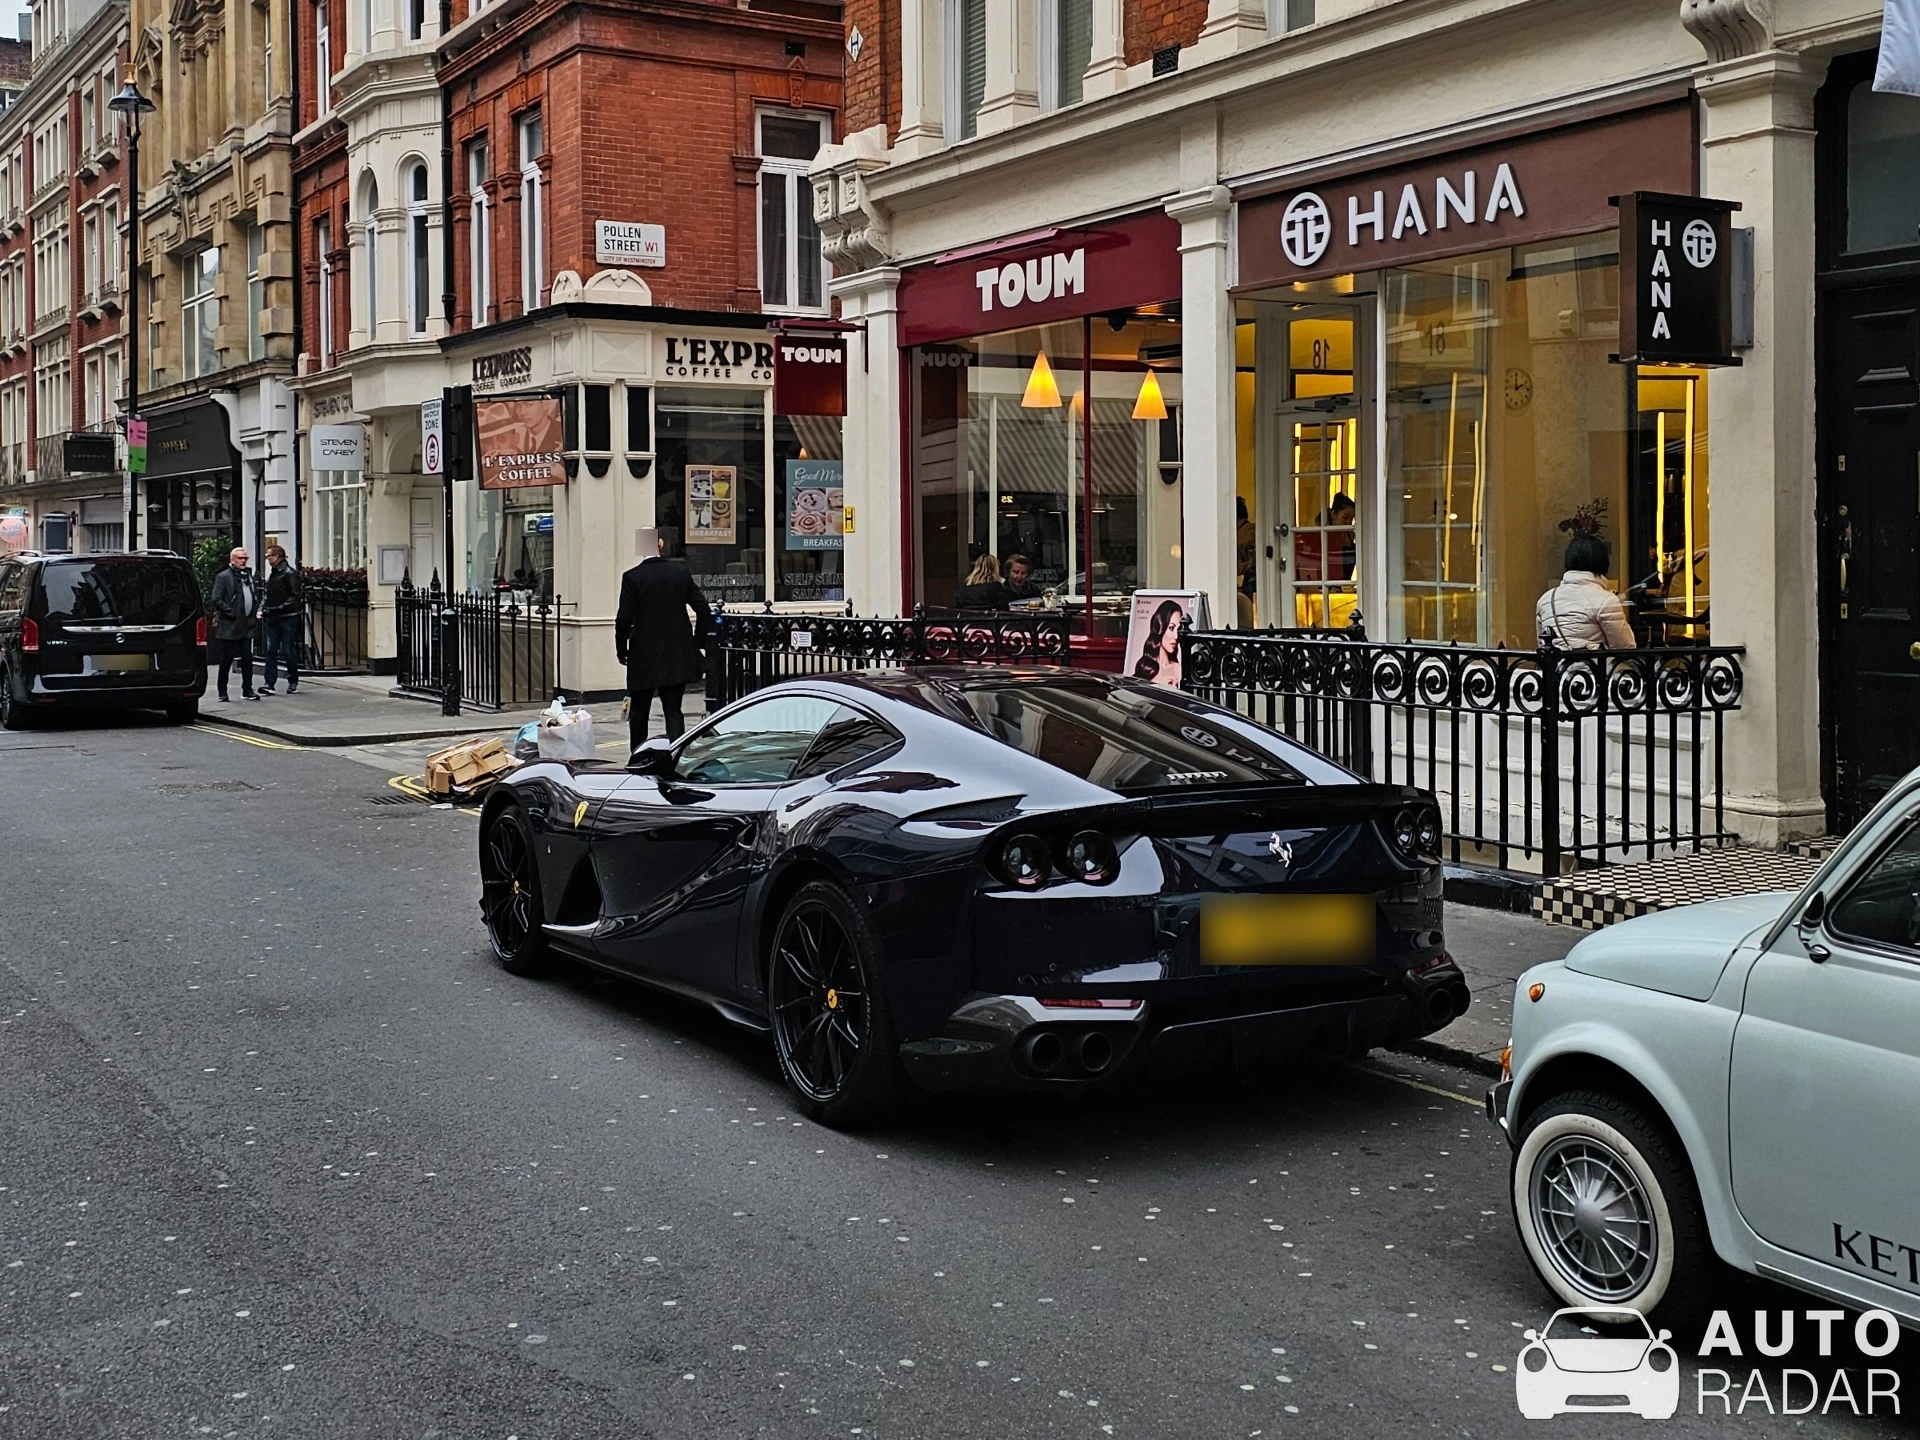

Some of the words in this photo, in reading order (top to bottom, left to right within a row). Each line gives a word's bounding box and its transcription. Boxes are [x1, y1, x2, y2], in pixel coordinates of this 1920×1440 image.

[1348, 162, 1526, 246] HANA
[603, 225, 641, 239] POLLEN
[604, 239, 641, 252] STREET
[644, 241, 658, 253] W1
[976, 247, 1085, 313] TOUM
[1651, 219, 1671, 339] HANA
[665, 337, 774, 368] L'EXPR
[781, 346, 842, 364] TOUM
[665, 366, 732, 379] COFFEE
[751, 369, 772, 380] CO
[425, 419, 439, 430] ZONE
[485, 452, 561, 468] L'EXPRESS
[498, 467, 551, 481] COFFEE
[794, 467, 820, 485] Good
[703, 574, 765, 587] CATERING
[784, 573, 813, 586] SELF
[1832, 1222, 1920, 1286] KET
